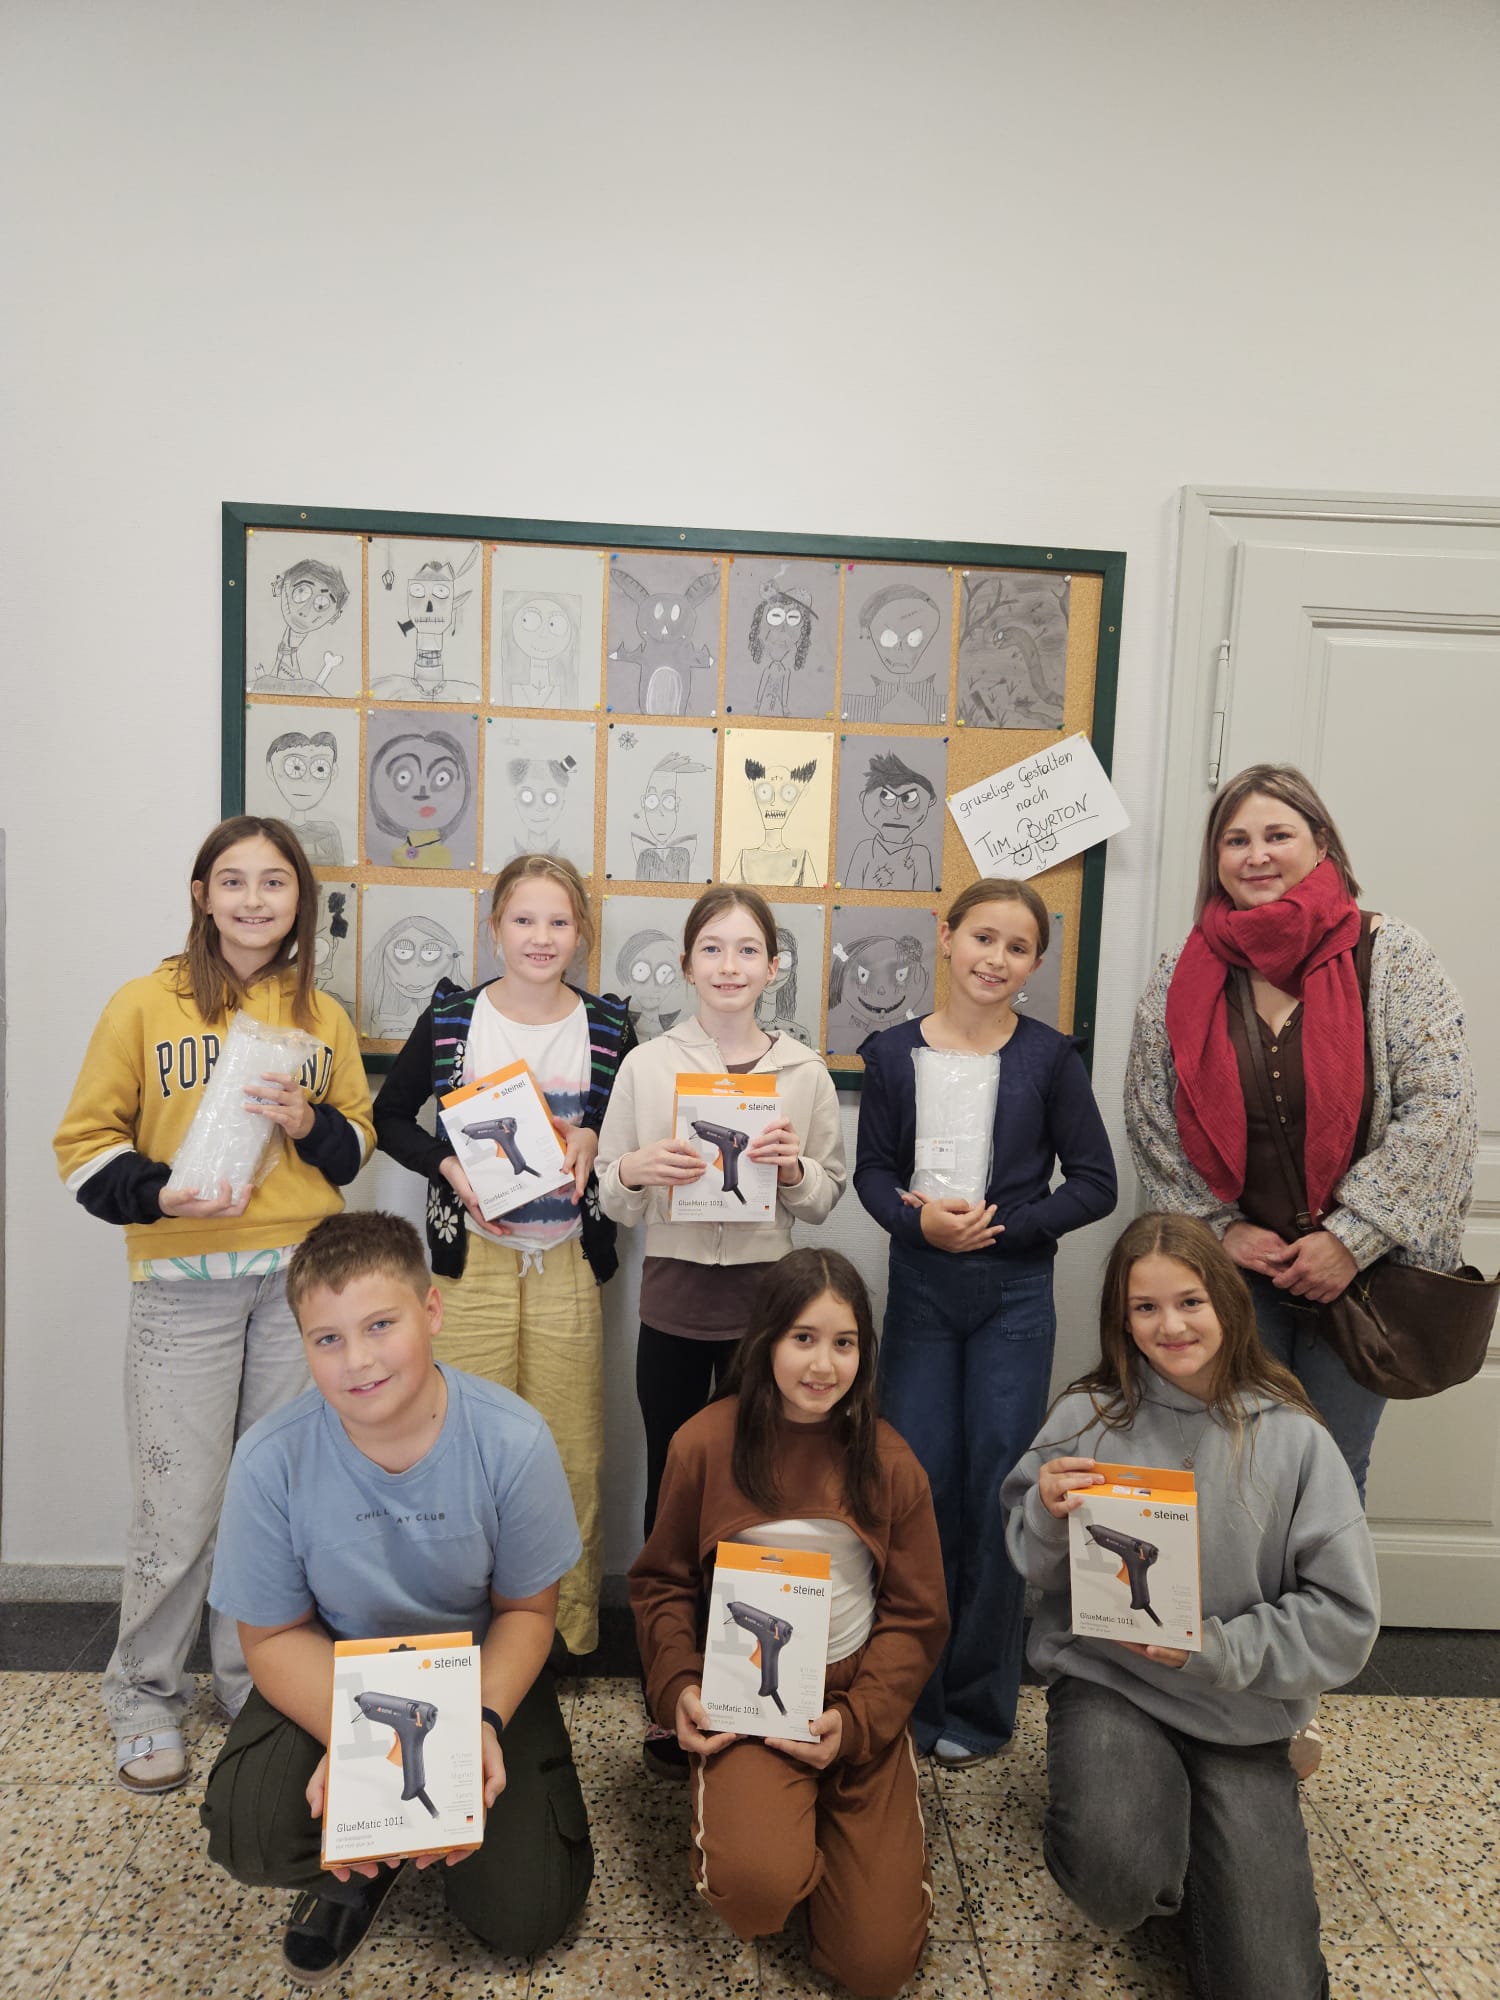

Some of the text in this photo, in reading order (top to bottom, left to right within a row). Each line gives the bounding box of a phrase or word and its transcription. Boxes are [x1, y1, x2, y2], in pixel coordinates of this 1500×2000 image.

[959, 751, 1073, 819] gruselige Gestalten
[1016, 786, 1049, 813] nach
[974, 793, 1088, 858] TIM BURTON
[748, 1103, 776, 1111] steinel
[355, 1508, 390, 1521] CHILL
[415, 1512, 446, 1521] CLUB
[1154, 1510, 1189, 1522] steinel
[793, 1584, 825, 1597] steinel
[1117, 1617, 1134, 1625] 1011
[434, 1656, 472, 1669] steinel
[707, 1702, 760, 1715] GlueMatic 1011
[336, 1816, 404, 1833] GlueMatic 1011
